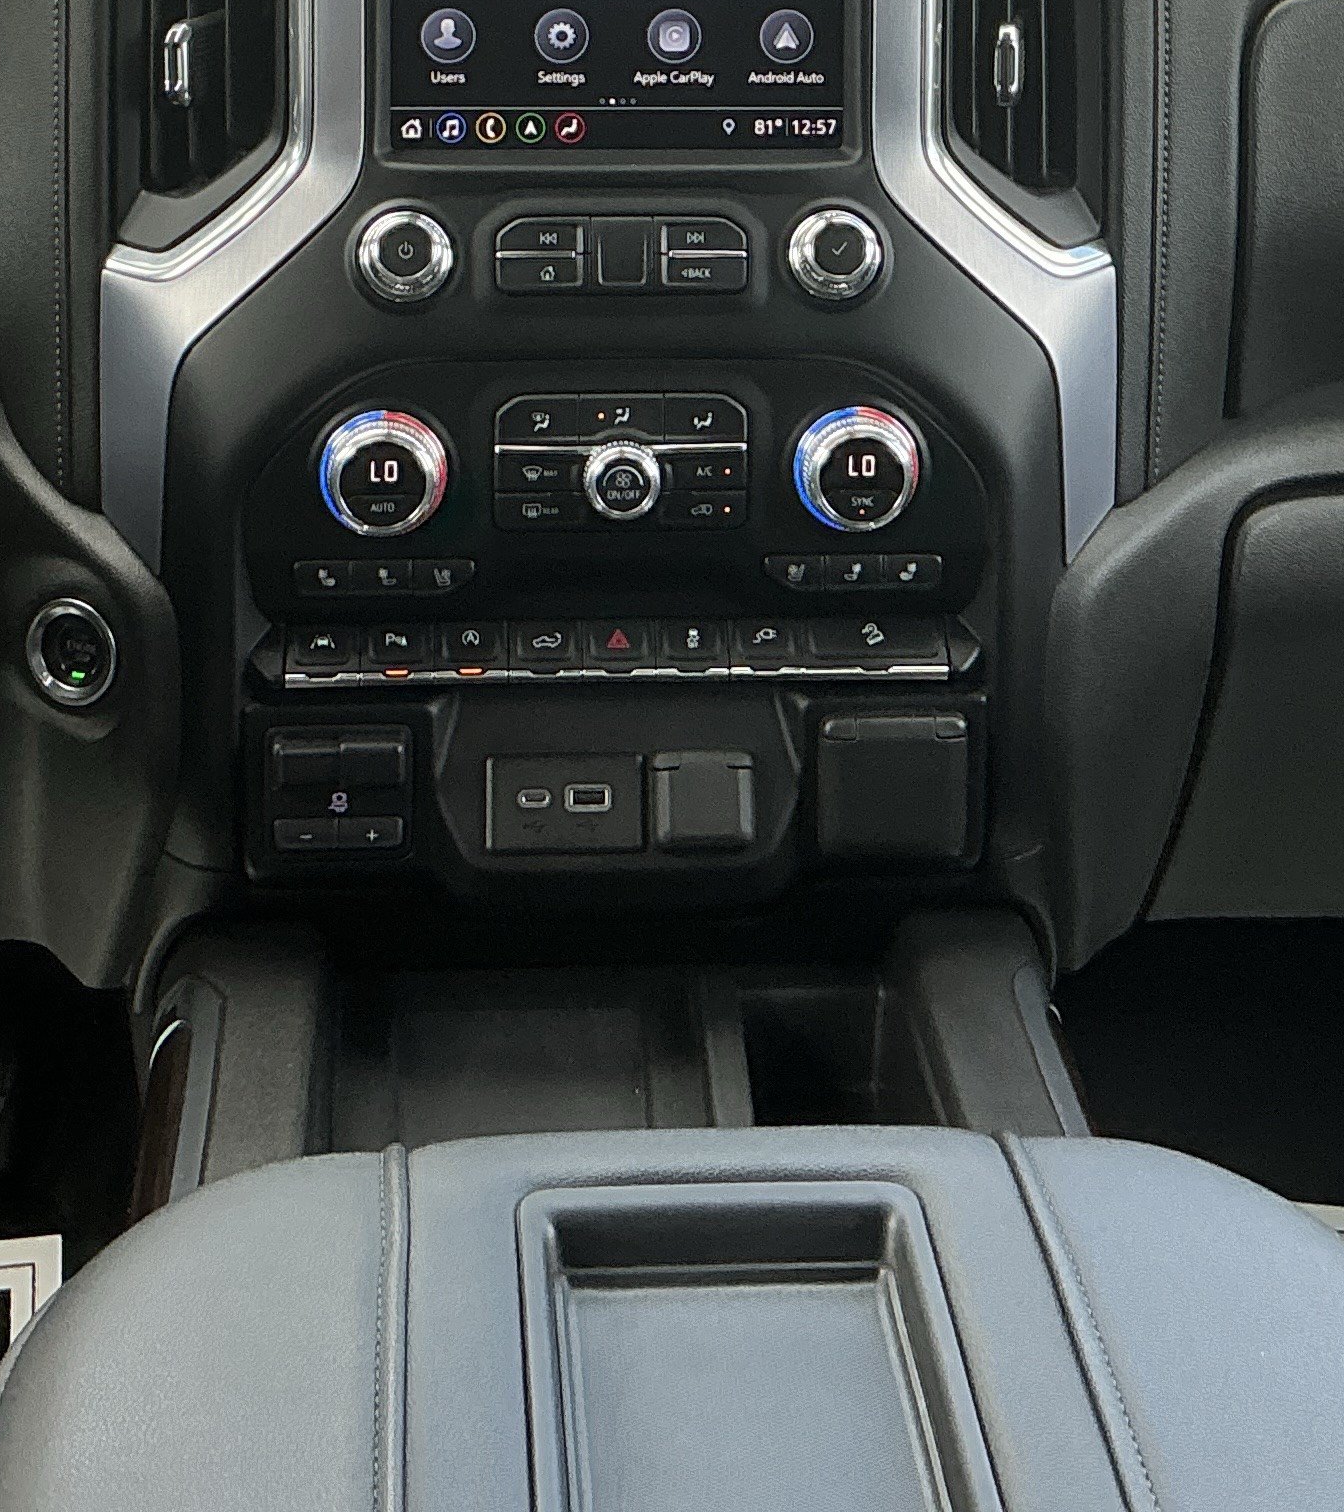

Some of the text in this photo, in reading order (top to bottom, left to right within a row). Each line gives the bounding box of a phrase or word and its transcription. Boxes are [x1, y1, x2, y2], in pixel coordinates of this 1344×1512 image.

[431, 72, 465, 85] Users
[537, 71, 586, 86] Settings
[633, 71, 715, 87] Apple CarPlay
[748, 71, 825, 85] Android Auto
[754, 118, 837, 136] 81° 12:57
[689, 268, 711, 278] BACK
[370, 460, 398, 482] LO
[696, 466, 712, 477] A/C
[848, 454, 876, 477] LO
[607, 490, 641, 501] ON/OFF
[851, 496, 874, 508] SYNC
[370, 502, 395, 513] AUTO
